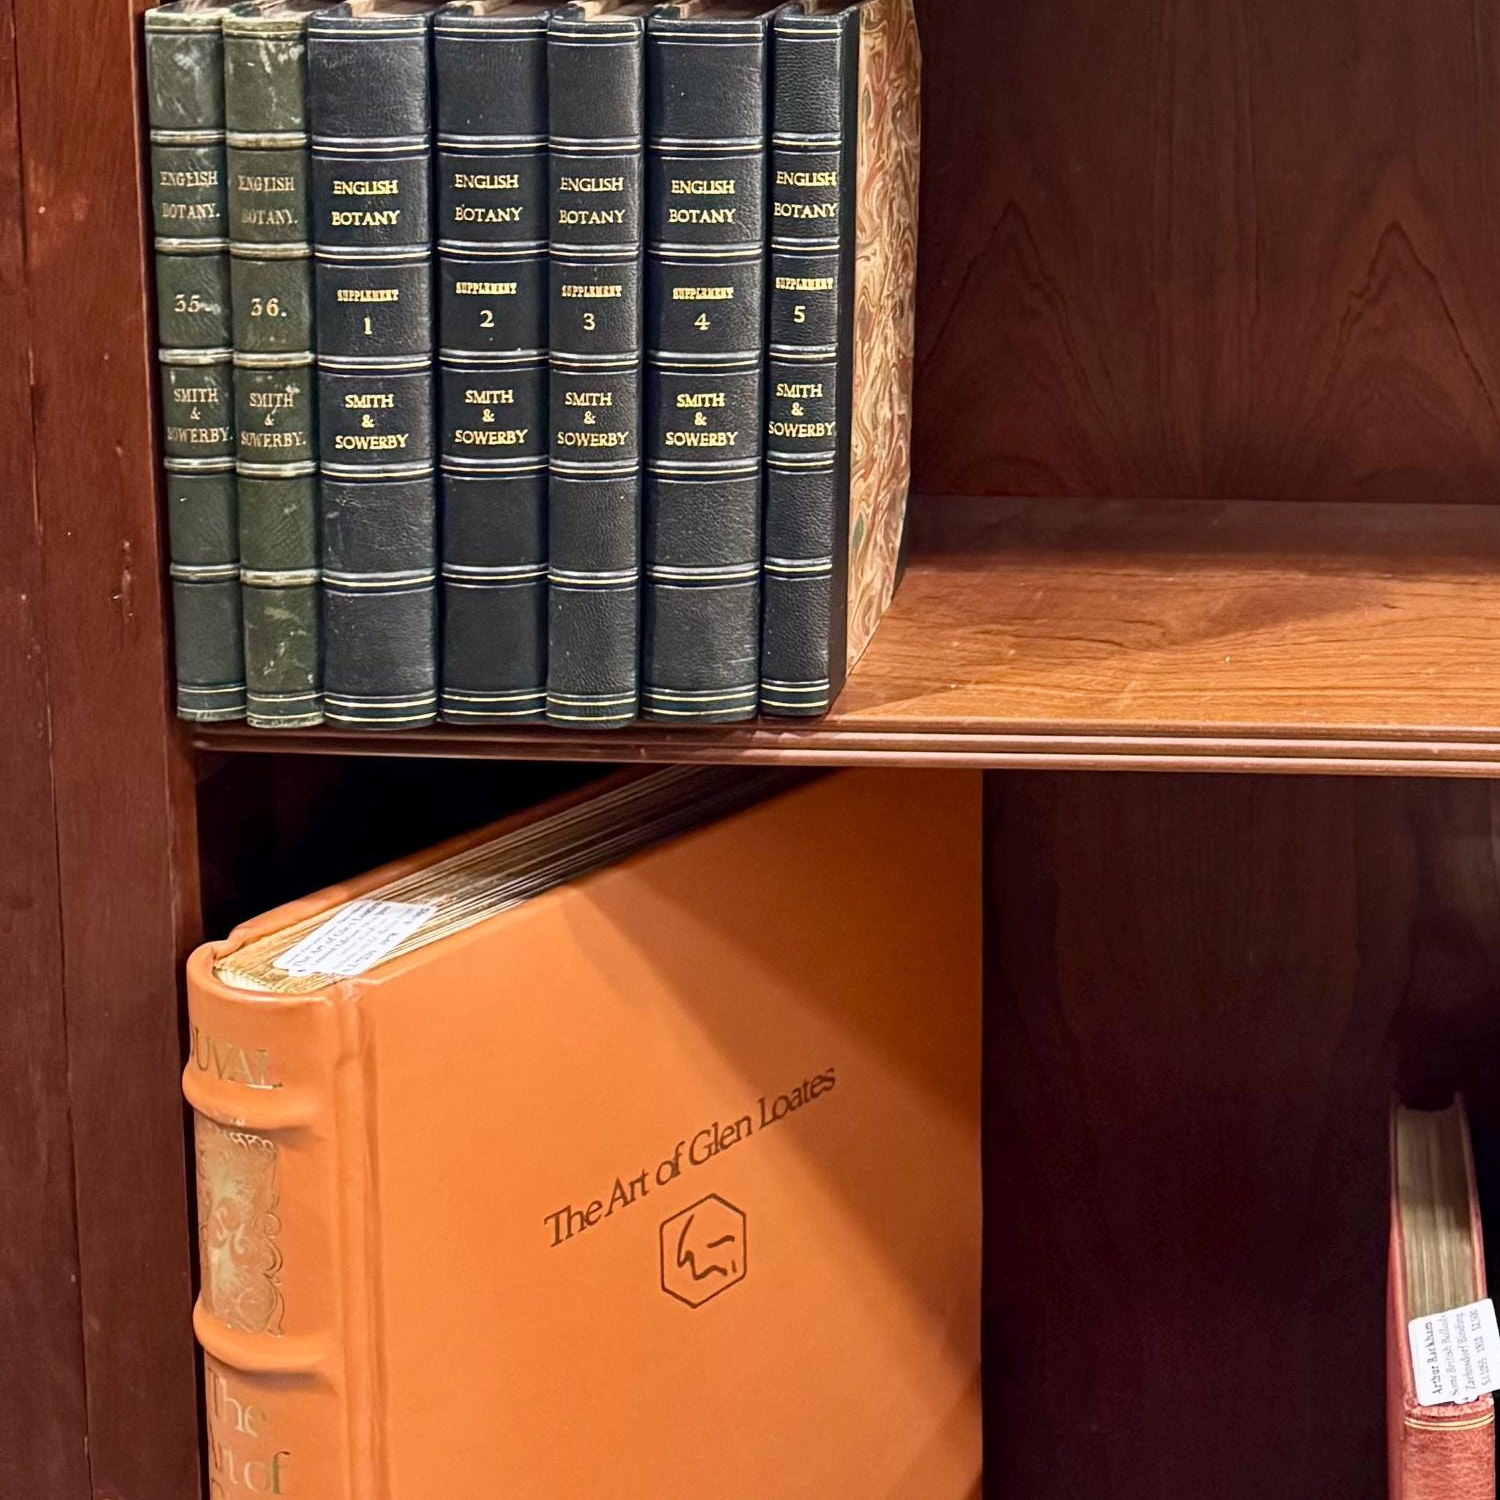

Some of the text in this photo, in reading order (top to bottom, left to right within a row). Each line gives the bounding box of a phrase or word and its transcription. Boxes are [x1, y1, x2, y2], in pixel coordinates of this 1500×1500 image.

[160, 170, 218, 188] ENGLISH
[238, 176, 295, 192] ENGLISH
[454, 174, 519, 189] ENGLISH
[560, 177, 625, 192] ENGLISH
[776, 171, 837, 187] ENGLISH
[332, 180, 399, 195] ENGLISH
[670, 180, 736, 195] ENGLISH
[162, 203, 221, 219] BOTANY.
[331, 210, 400, 226] BOTANY
[454, 205, 524, 222] BOTANY
[558, 209, 626, 225] BOTANY
[668, 208, 736, 224] BOTANY
[773, 202, 837, 218] BOTANY
[337, 289, 399, 302] SUPPLEMENT
[455, 281, 517, 296] SUPPLEMENT
[250, 298, 287, 317] 36.
[793, 306, 806, 324] 5
[364, 317, 373, 335] 1
[480, 310, 494, 328] 2
[583, 313, 596, 331] 3
[693, 313, 711, 331] 4
[173, 388, 219, 403] SMITH
[465, 390, 513, 404] SMITH
[776, 383, 823, 398] SMITH
[249, 392, 294, 408] SMITH
[344, 393, 394, 409] SMITH
[565, 391, 613, 407] SMITH
[676, 393, 726, 408] SMITH
[190, 407, 201, 420] &
[482, 408, 495, 422] &
[583, 411, 596, 425] &
[791, 403, 804, 417] &
[264, 414, 275, 426] &
[361, 414, 375, 428] &
[694, 412, 708, 426] &
[455, 429, 528, 445] SOWERBY
[768, 421, 836, 438] SOWERBY
[240, 431, 307, 447] SOWERBY.
[335, 433, 409, 450] SOWERBY
[557, 430, 629, 447] SOWERBY
[665, 431, 738, 447] SOWERBY
[543, 1067, 836, 1248] The Art of Glen Loates
[1429, 1362, 1442, 1396] Arthur
